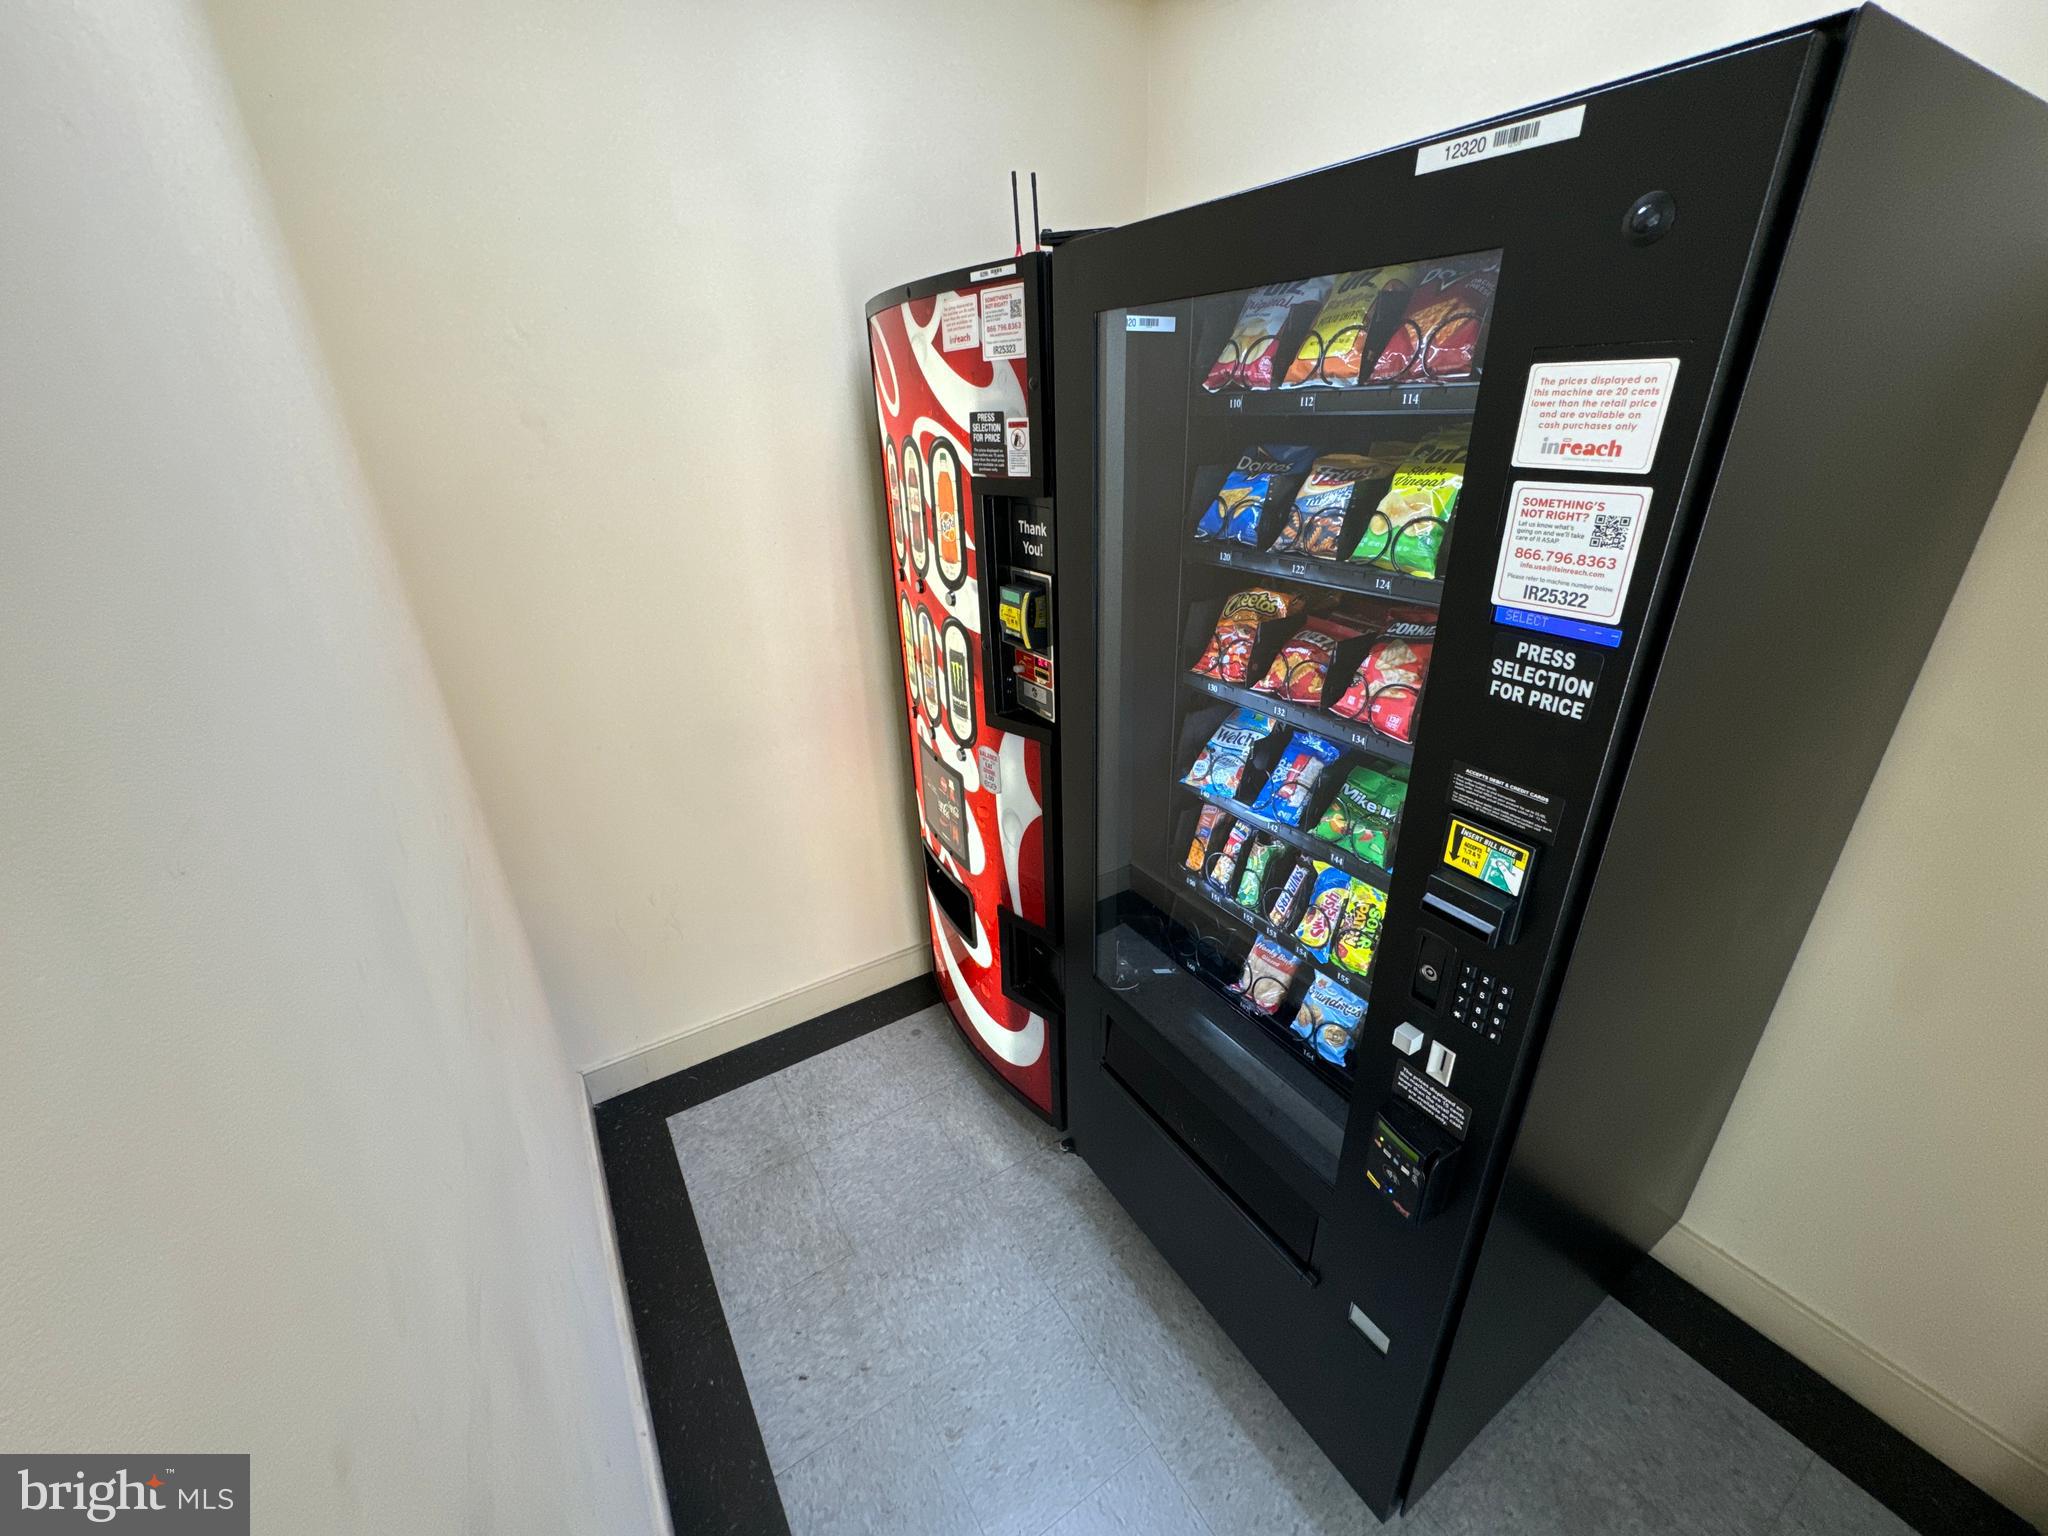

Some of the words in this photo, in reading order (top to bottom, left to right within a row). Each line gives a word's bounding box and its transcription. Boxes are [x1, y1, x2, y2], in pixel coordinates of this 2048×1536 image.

[1445, 136, 1487, 161] 12320
[993, 344, 1016, 355] IR25323
[1541, 377, 1556, 386] The
[1558, 376, 1588, 387] prices
[1590, 375, 1641, 387] displayed
[1644, 376, 1658, 384] on
[1534, 388, 1549, 396] this
[1552, 388, 1594, 396] machine
[1631, 387, 1660, 396] cents
[1229, 398, 1242, 409] 110
[1300, 396, 1314, 407] 112
[1402, 394, 1419, 405] 114
[1531, 399, 1556, 407] lower
[1559, 399, 1580, 407] than
[1582, 399, 1598, 407] the
[1600, 399, 1627, 407] retail
[1630, 399, 1657, 409] price
[977, 413, 995, 422] PRESS
[1539, 410, 1557, 418] and
[1578, 411, 1625, 419] available
[972, 423, 1001, 432] SELECTION
[1562, 422, 1613, 431] purchases
[1615, 422, 1638, 432] only
[973, 433, 984, 442] FOR
[985, 433, 1001, 442] PRICE
[1541, 437, 1623, 457] inreach
[1394, 475, 1446, 492] Vinegar
[1522, 497, 1606, 512] SOMETHING'S
[1520, 509, 1544, 519] NOT
[1545, 510, 1590, 523] RIGHT?
[1018, 519, 1047, 537] Thank
[1536, 521, 1551, 529] know
[1516, 528, 1532, 537] going
[1570, 531, 1585, 539] take
[1541, 536, 1560, 544] ASAP
[1023, 541, 1043, 557] You!
[1219, 551, 1231, 561] 120
[1514, 547, 1617, 570] 866.796.8363
[1292, 564, 1304, 575] 122
[1375, 578, 1391, 590] 124
[1523, 585, 1589, 609] IR25322
[1505, 609, 1549, 627] SELECT
[1516, 641, 1576, 670] PRESS
[1491, 658, 1594, 699] SELECTION
[1207, 683, 1218, 692] 130
[1489, 680, 1525, 704] FOR
[1528, 690, 1585, 720] PRICE
[1273, 706, 1286, 717] 132
[1351, 734, 1366, 745] 134
[1340, 782, 1377, 813] Mike
[1267, 821, 1279, 833] 142
[1461, 828, 1484, 842] INSERT
[1484, 838, 1498, 849] BILL
[1499, 845, 1518, 857] HERE
[1330, 853, 1344, 865] 144
[1243, 913, 1254, 923] 152
[1310, 892, 1339, 937] Swish
[1338, 972, 1349, 984] 155
[1501, 987, 1508, 995] 3
[1471, 1021, 1478, 1029] 0
[1409, 1078, 1431, 1096] machine
[1449, 1107, 1465, 1120] cents
[1413, 1075, 1429, 1089] prices
[1429, 1086, 1456, 1107] displayed
[1456, 1105, 1464, 1113] on
[1417, 1095, 1441, 1114] available
[1449, 1119, 1463, 1131] cash
[1449, 1113, 1464, 1126] price
